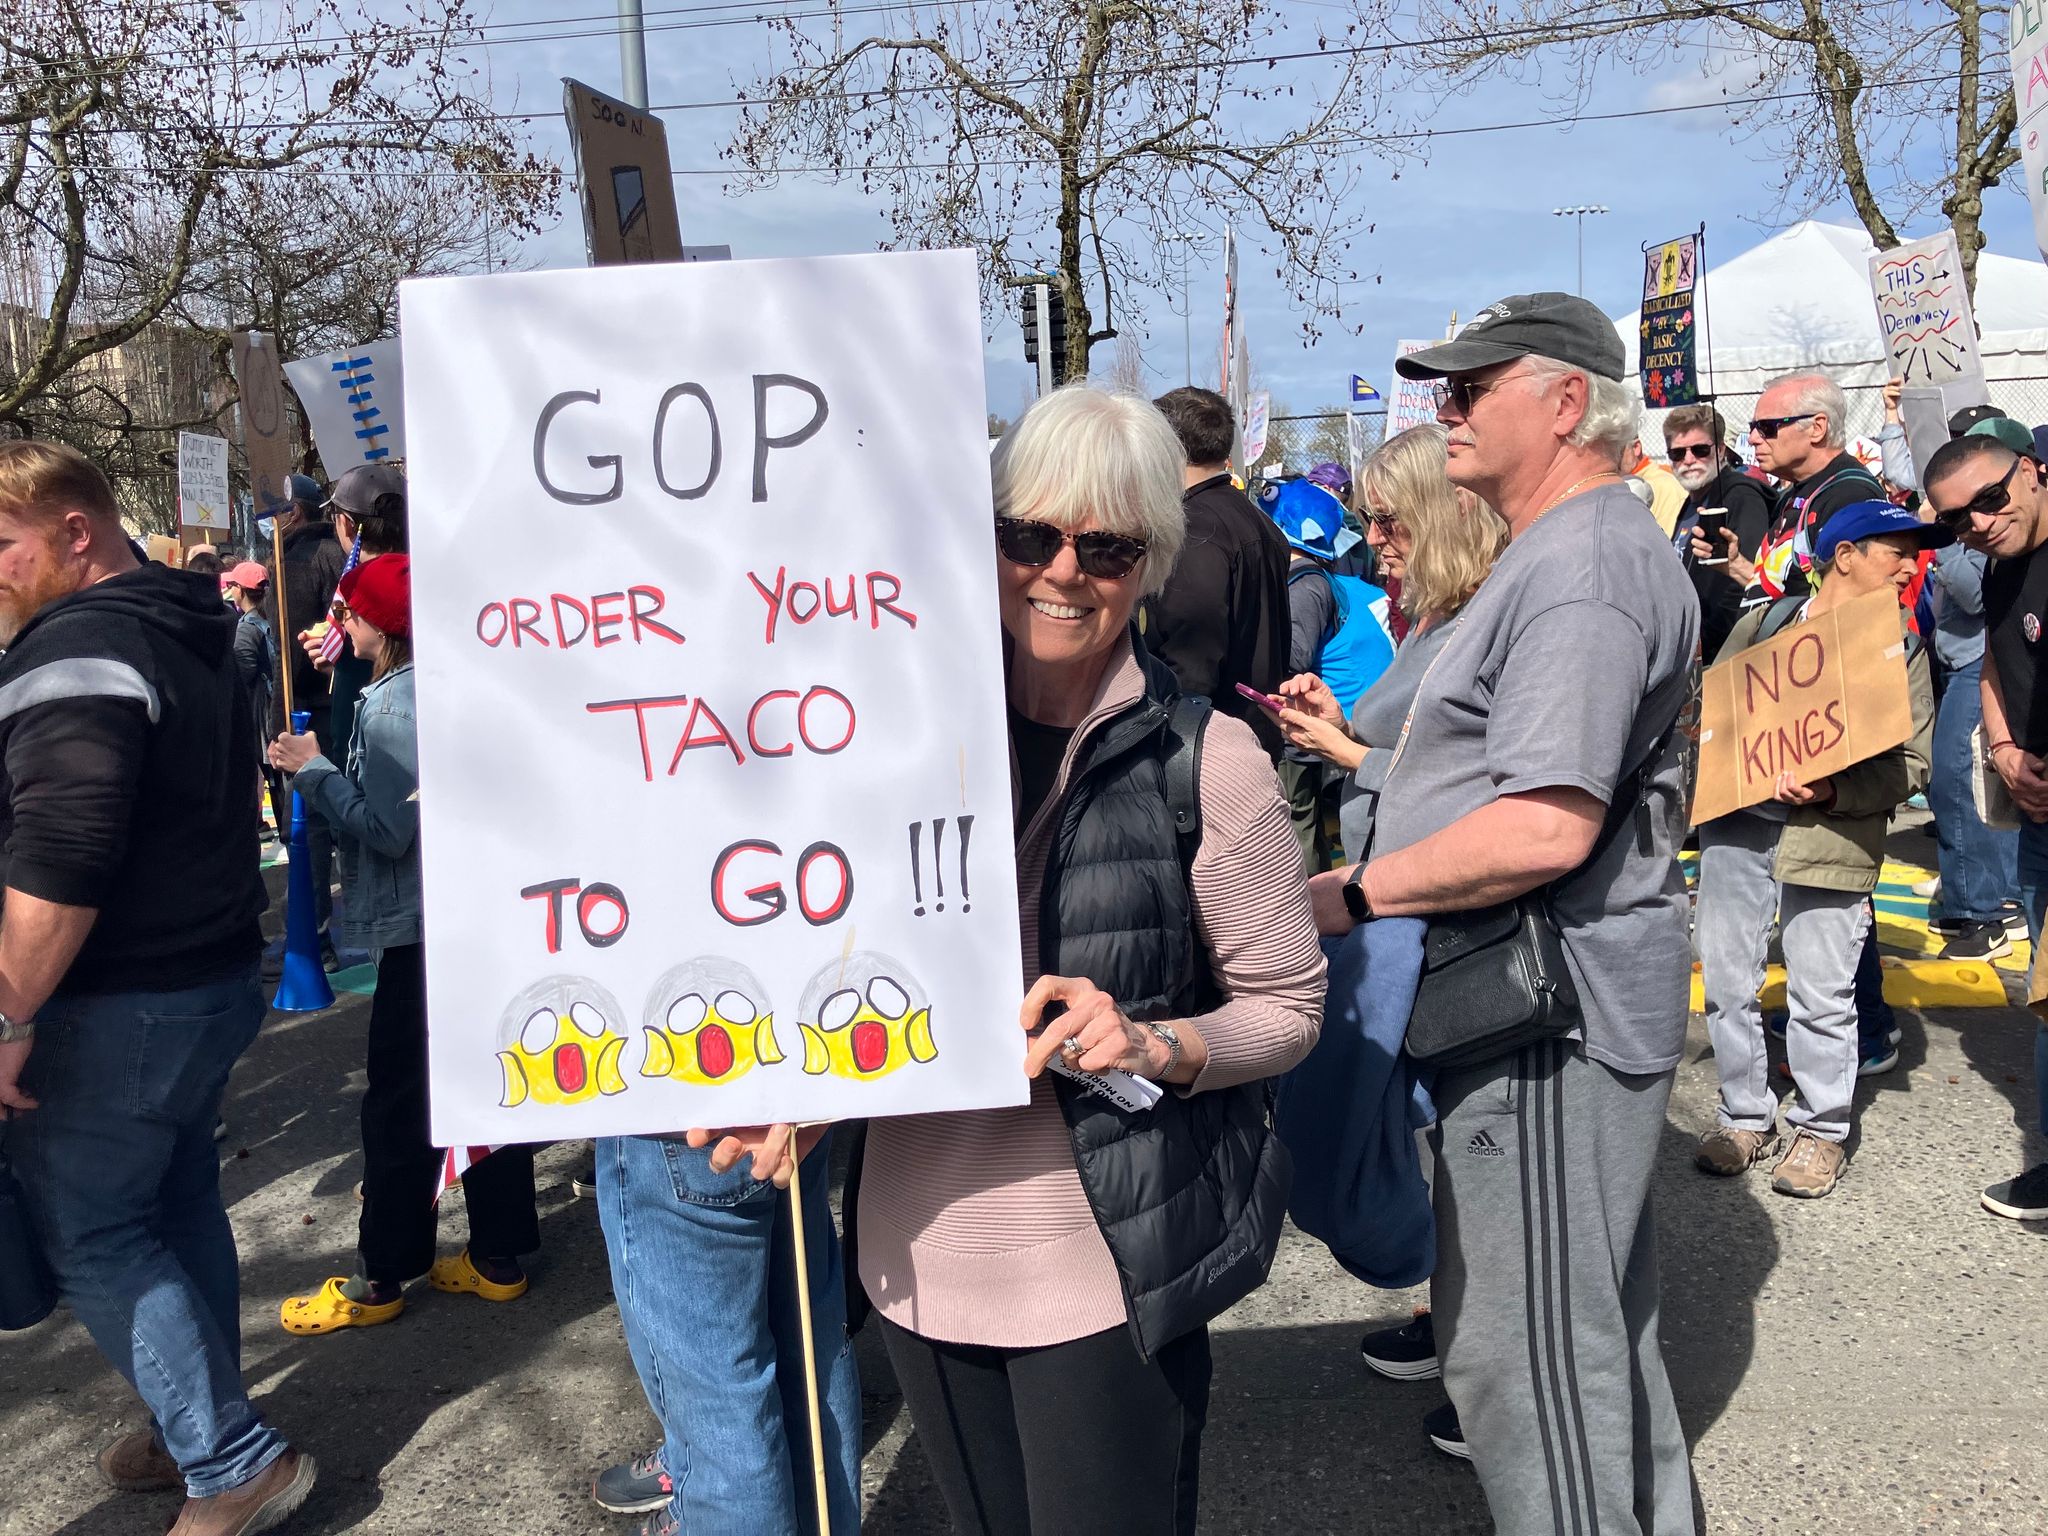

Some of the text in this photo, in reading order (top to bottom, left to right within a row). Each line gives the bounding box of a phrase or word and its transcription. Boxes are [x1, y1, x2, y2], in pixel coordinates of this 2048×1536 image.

[1885, 262, 1925, 292] THIS
[1643, 293, 1691, 315] RADICALIZED
[1657, 315, 1670, 330] BY
[1884, 308, 1950, 335] Democracy
[1653, 333, 1677, 350] BASIC
[1645, 351, 1685, 370] DECENCY
[207, 438, 222, 457] NET
[477, 566, 917, 649] ORDER YOUR
[1745, 633, 1824, 714] NO
[586, 685, 857, 782] TACO
[1743, 700, 1845, 784] KINGS
[520, 814, 975, 954] TO GO !!!
[1084, 1072, 1118, 1096] MORE
[1117, 1095, 1134, 1109] NO
[1467, 1145, 1505, 1157] adidas
